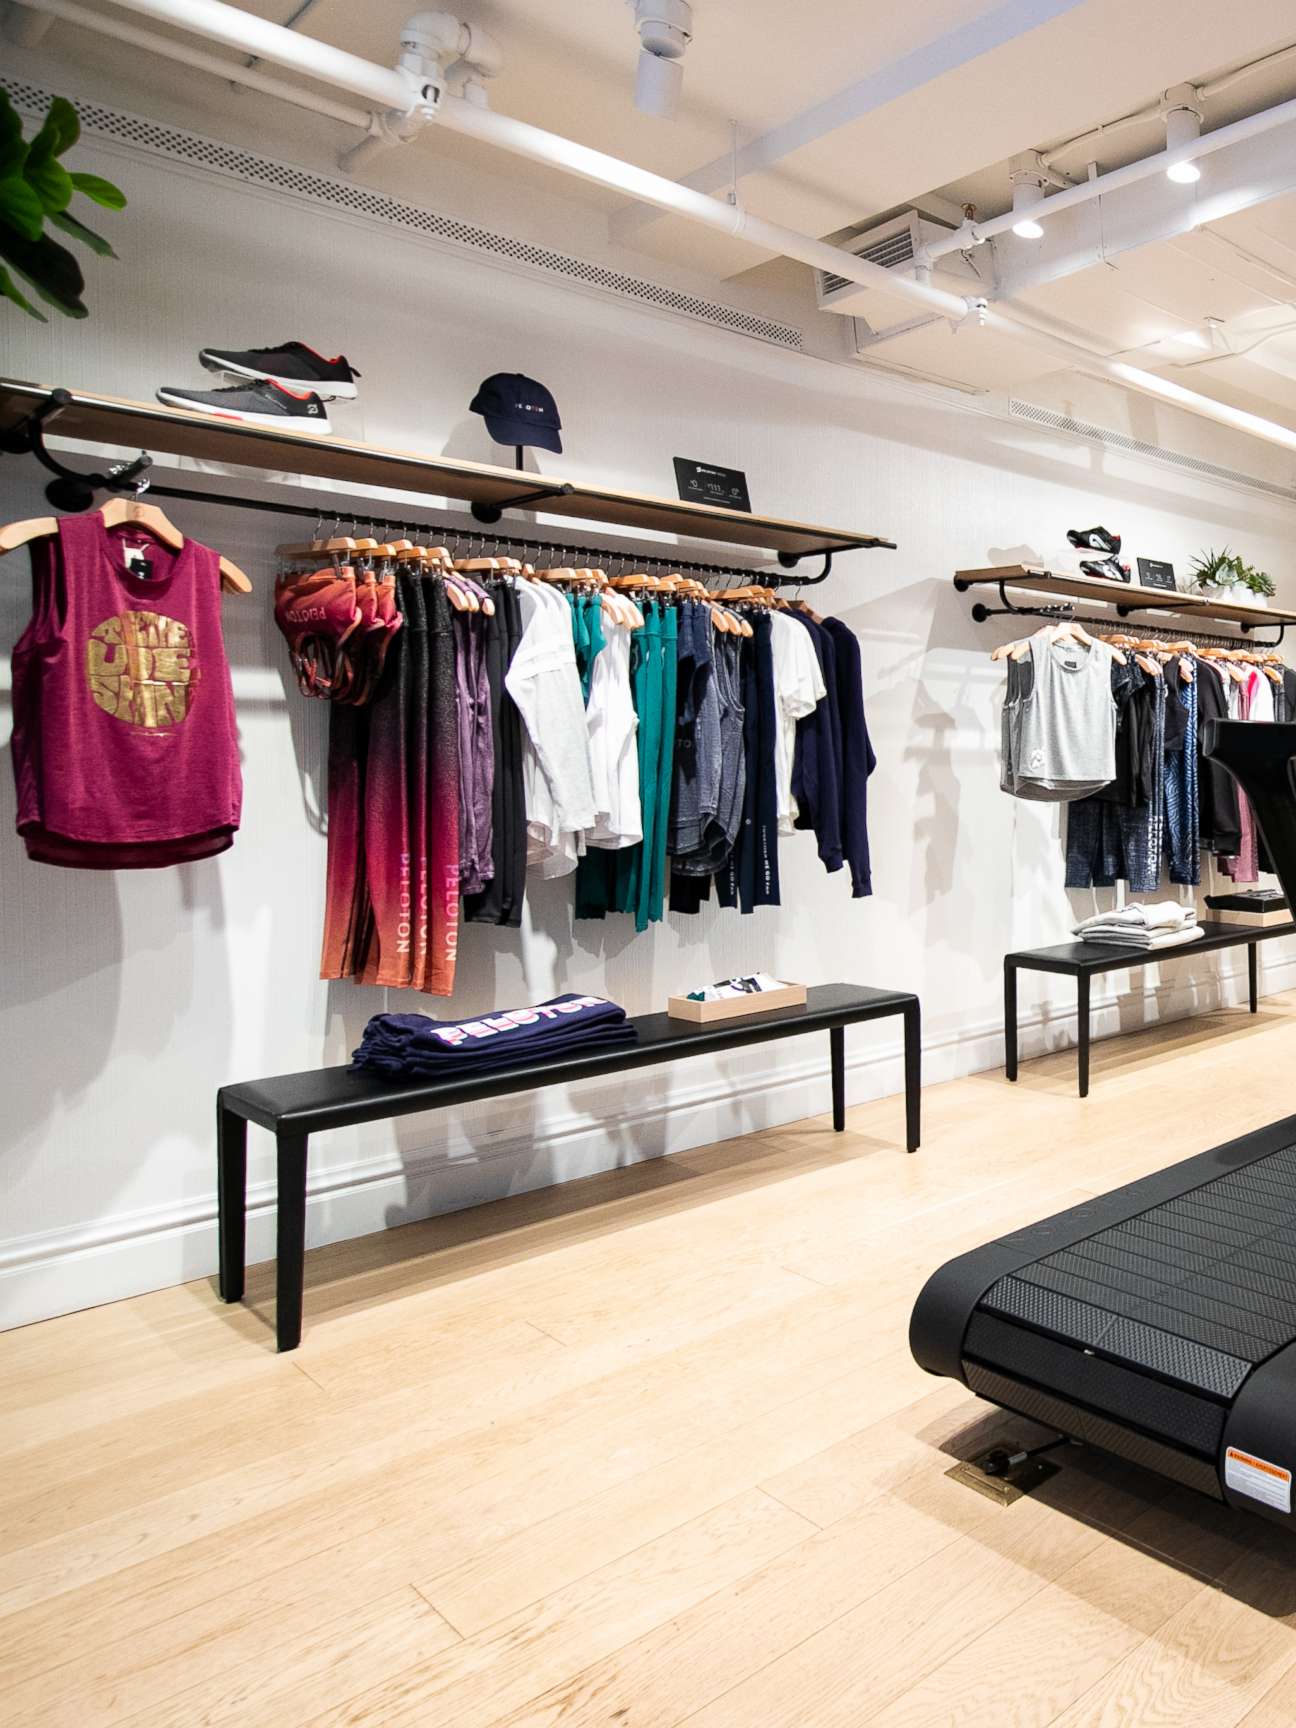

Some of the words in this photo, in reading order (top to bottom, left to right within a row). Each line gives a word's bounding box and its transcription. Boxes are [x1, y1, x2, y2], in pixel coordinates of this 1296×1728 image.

[396, 852, 411, 953] PELOTON
[445, 864, 460, 961] PELOTON
[430, 996, 609, 1046] PELOTON
